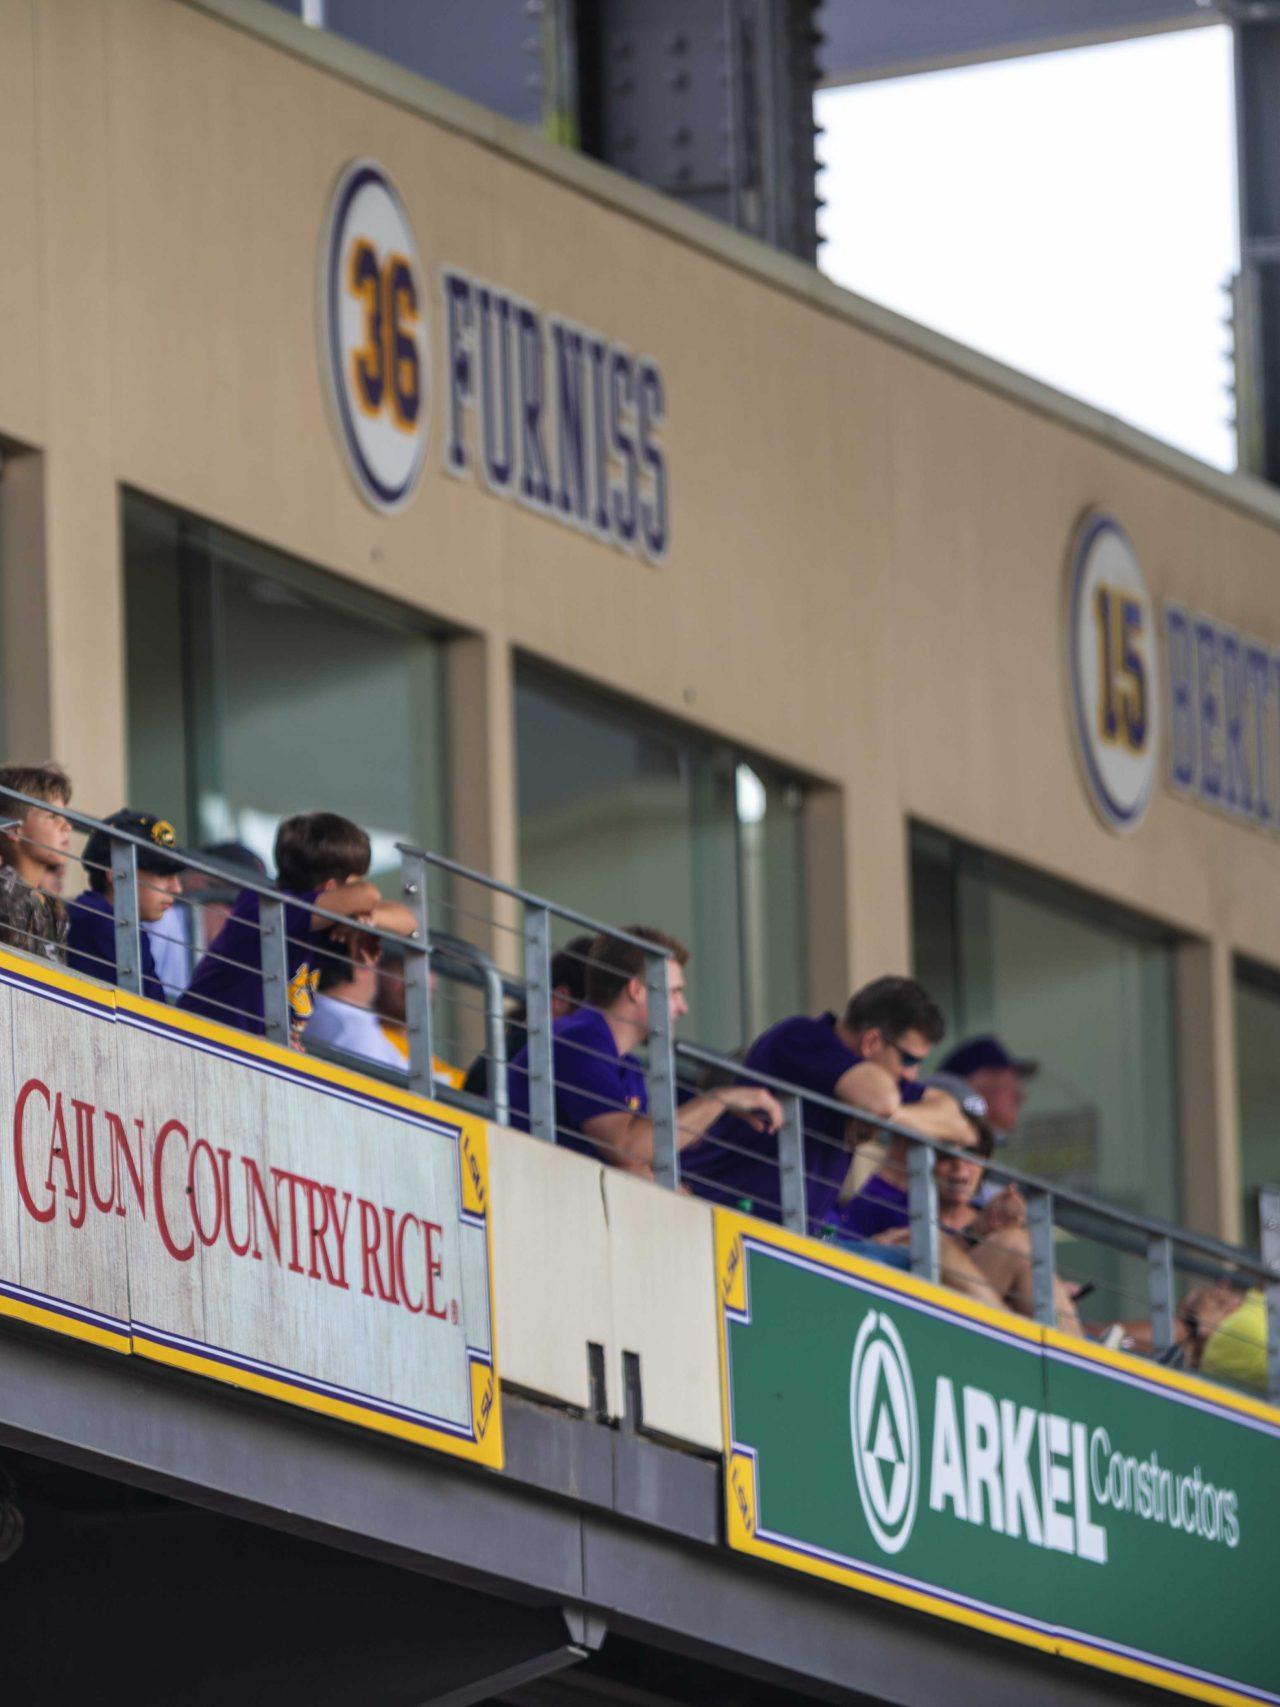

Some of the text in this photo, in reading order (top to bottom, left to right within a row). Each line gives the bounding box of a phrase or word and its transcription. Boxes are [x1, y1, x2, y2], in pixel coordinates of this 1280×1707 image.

[349, 237, 666, 558] 36 FURNISS
[1093, 582, 1147, 757] 15
[13, 1078, 448, 1320] CAJUN COUNTRY RICE
[929, 1374, 1239, 1566] ARKEL Constructors
